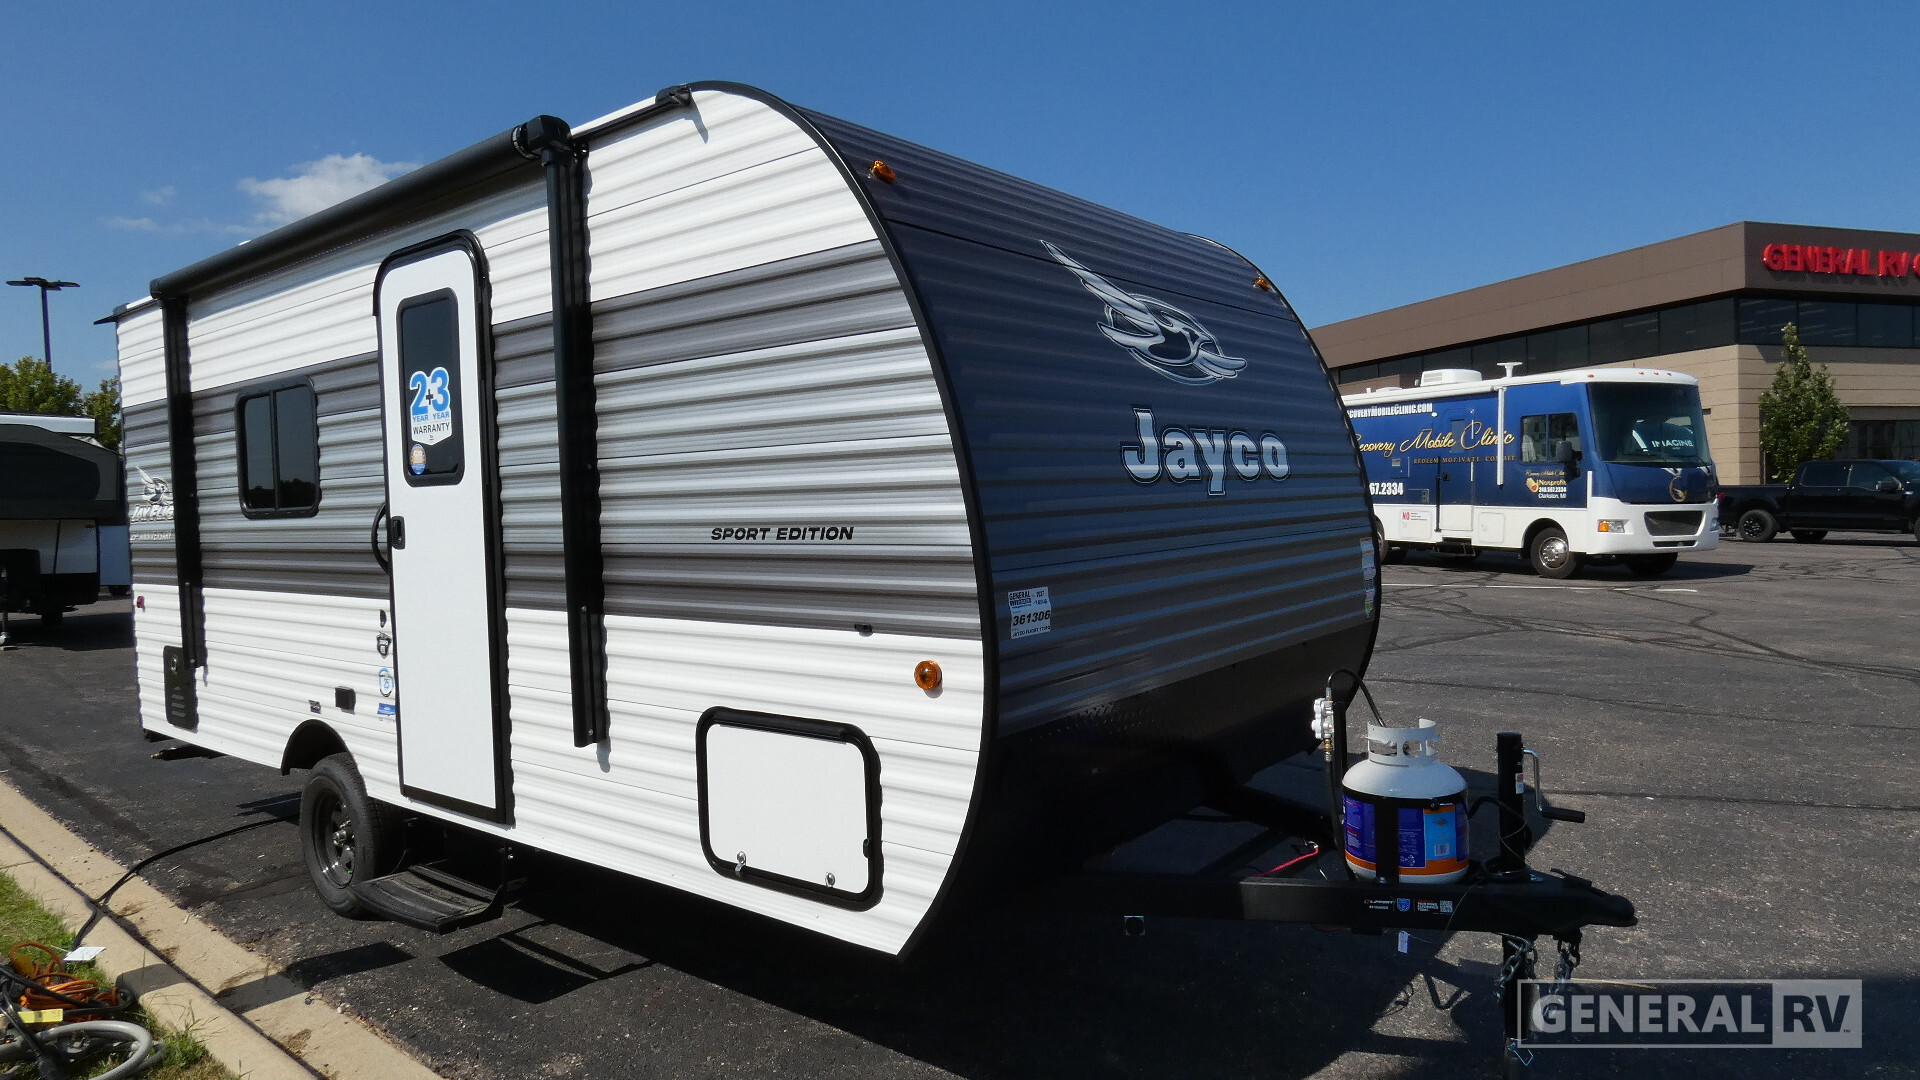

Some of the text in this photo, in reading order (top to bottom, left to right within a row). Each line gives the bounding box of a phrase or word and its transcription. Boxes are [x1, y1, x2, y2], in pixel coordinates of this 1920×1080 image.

[1762, 243, 1877, 275] GENERAL
[1878, 250, 1910, 277] RV
[412, 411, 450, 423] YEAR YEAR
[412, 422, 450, 435] WARRANTY
[1399, 428, 1457, 453] Mobile
[1119, 405, 1291, 496] Jayco
[710, 526, 855, 541] SPORT EDITION
[1013, 610, 1051, 626] 361306
